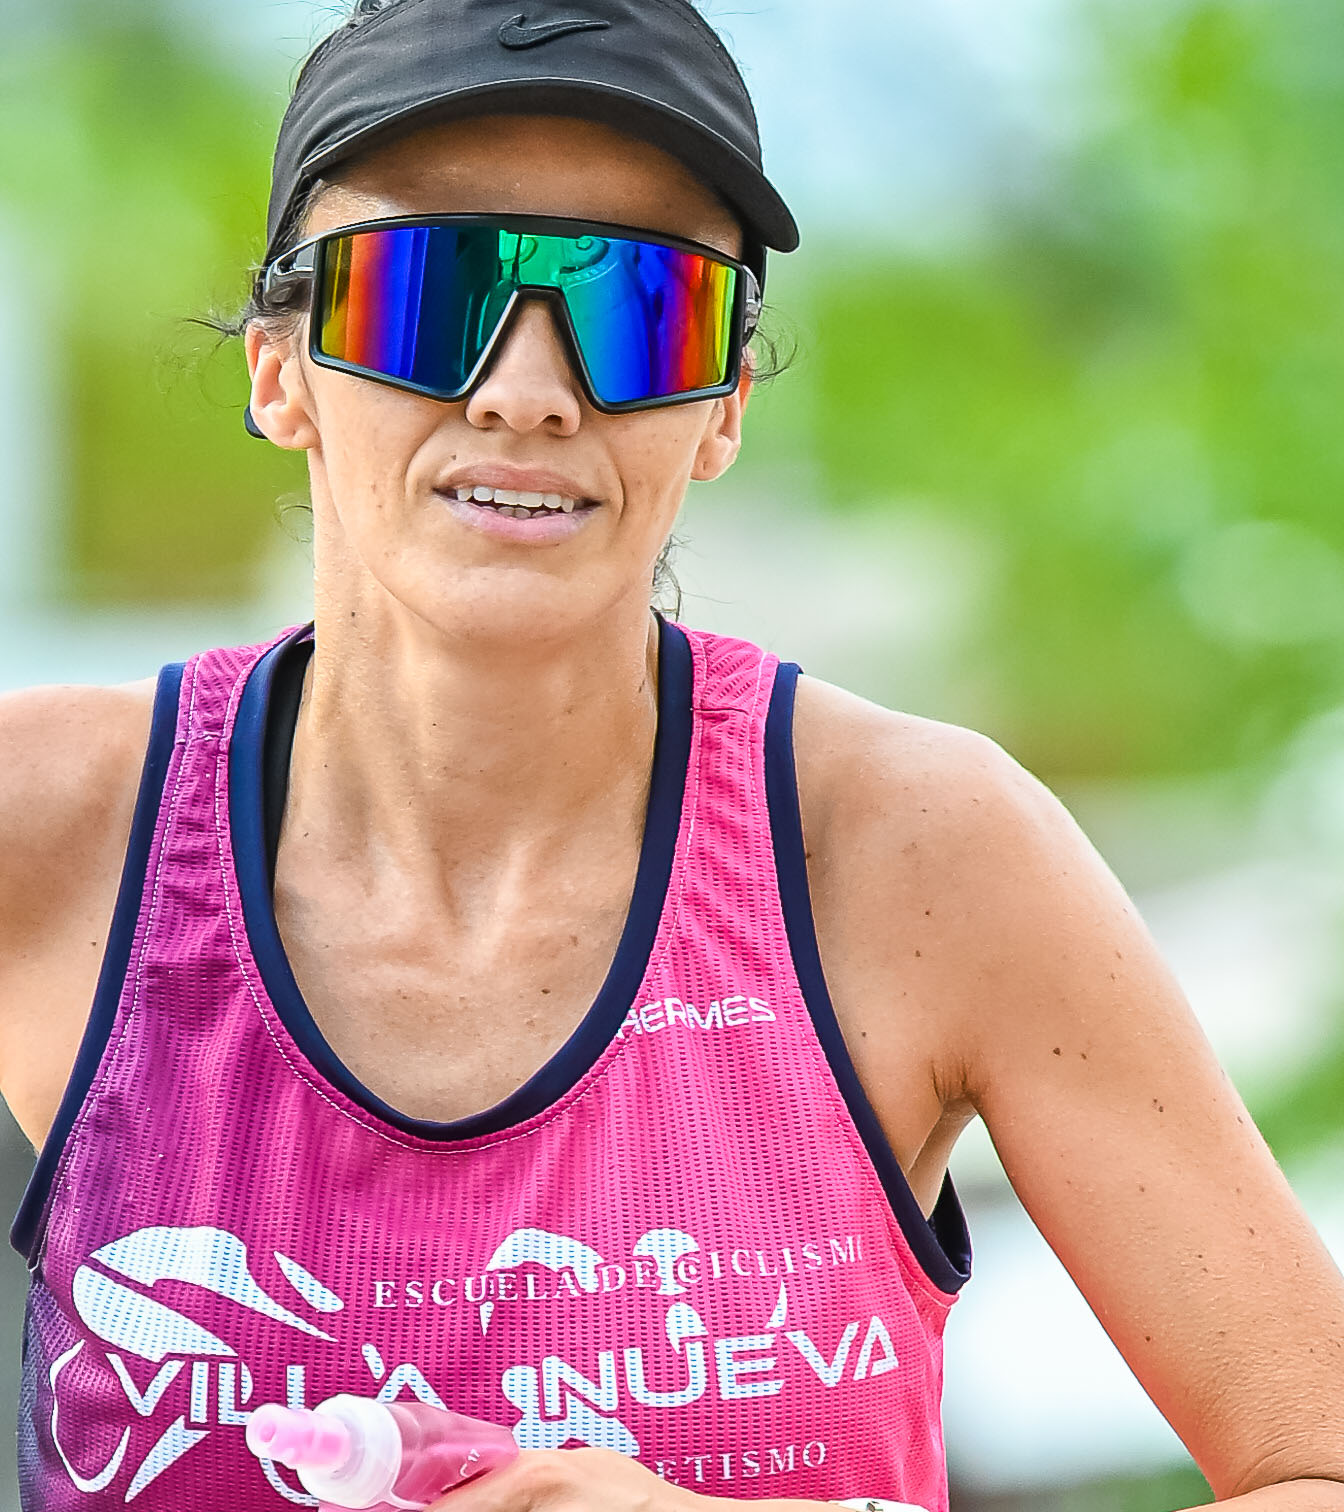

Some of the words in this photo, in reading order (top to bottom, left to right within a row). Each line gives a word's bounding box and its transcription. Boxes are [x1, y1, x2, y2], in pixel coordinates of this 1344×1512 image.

[616, 995, 777, 1039] HERMES
[372, 1271, 581, 1308] ESCUELA
[600, 1259, 657, 1293] DE
[677, 1234, 862, 1284] CICLISM
[541, 1315, 899, 1417] NUEVA
[654, 1440, 827, 1484] ETISMO
